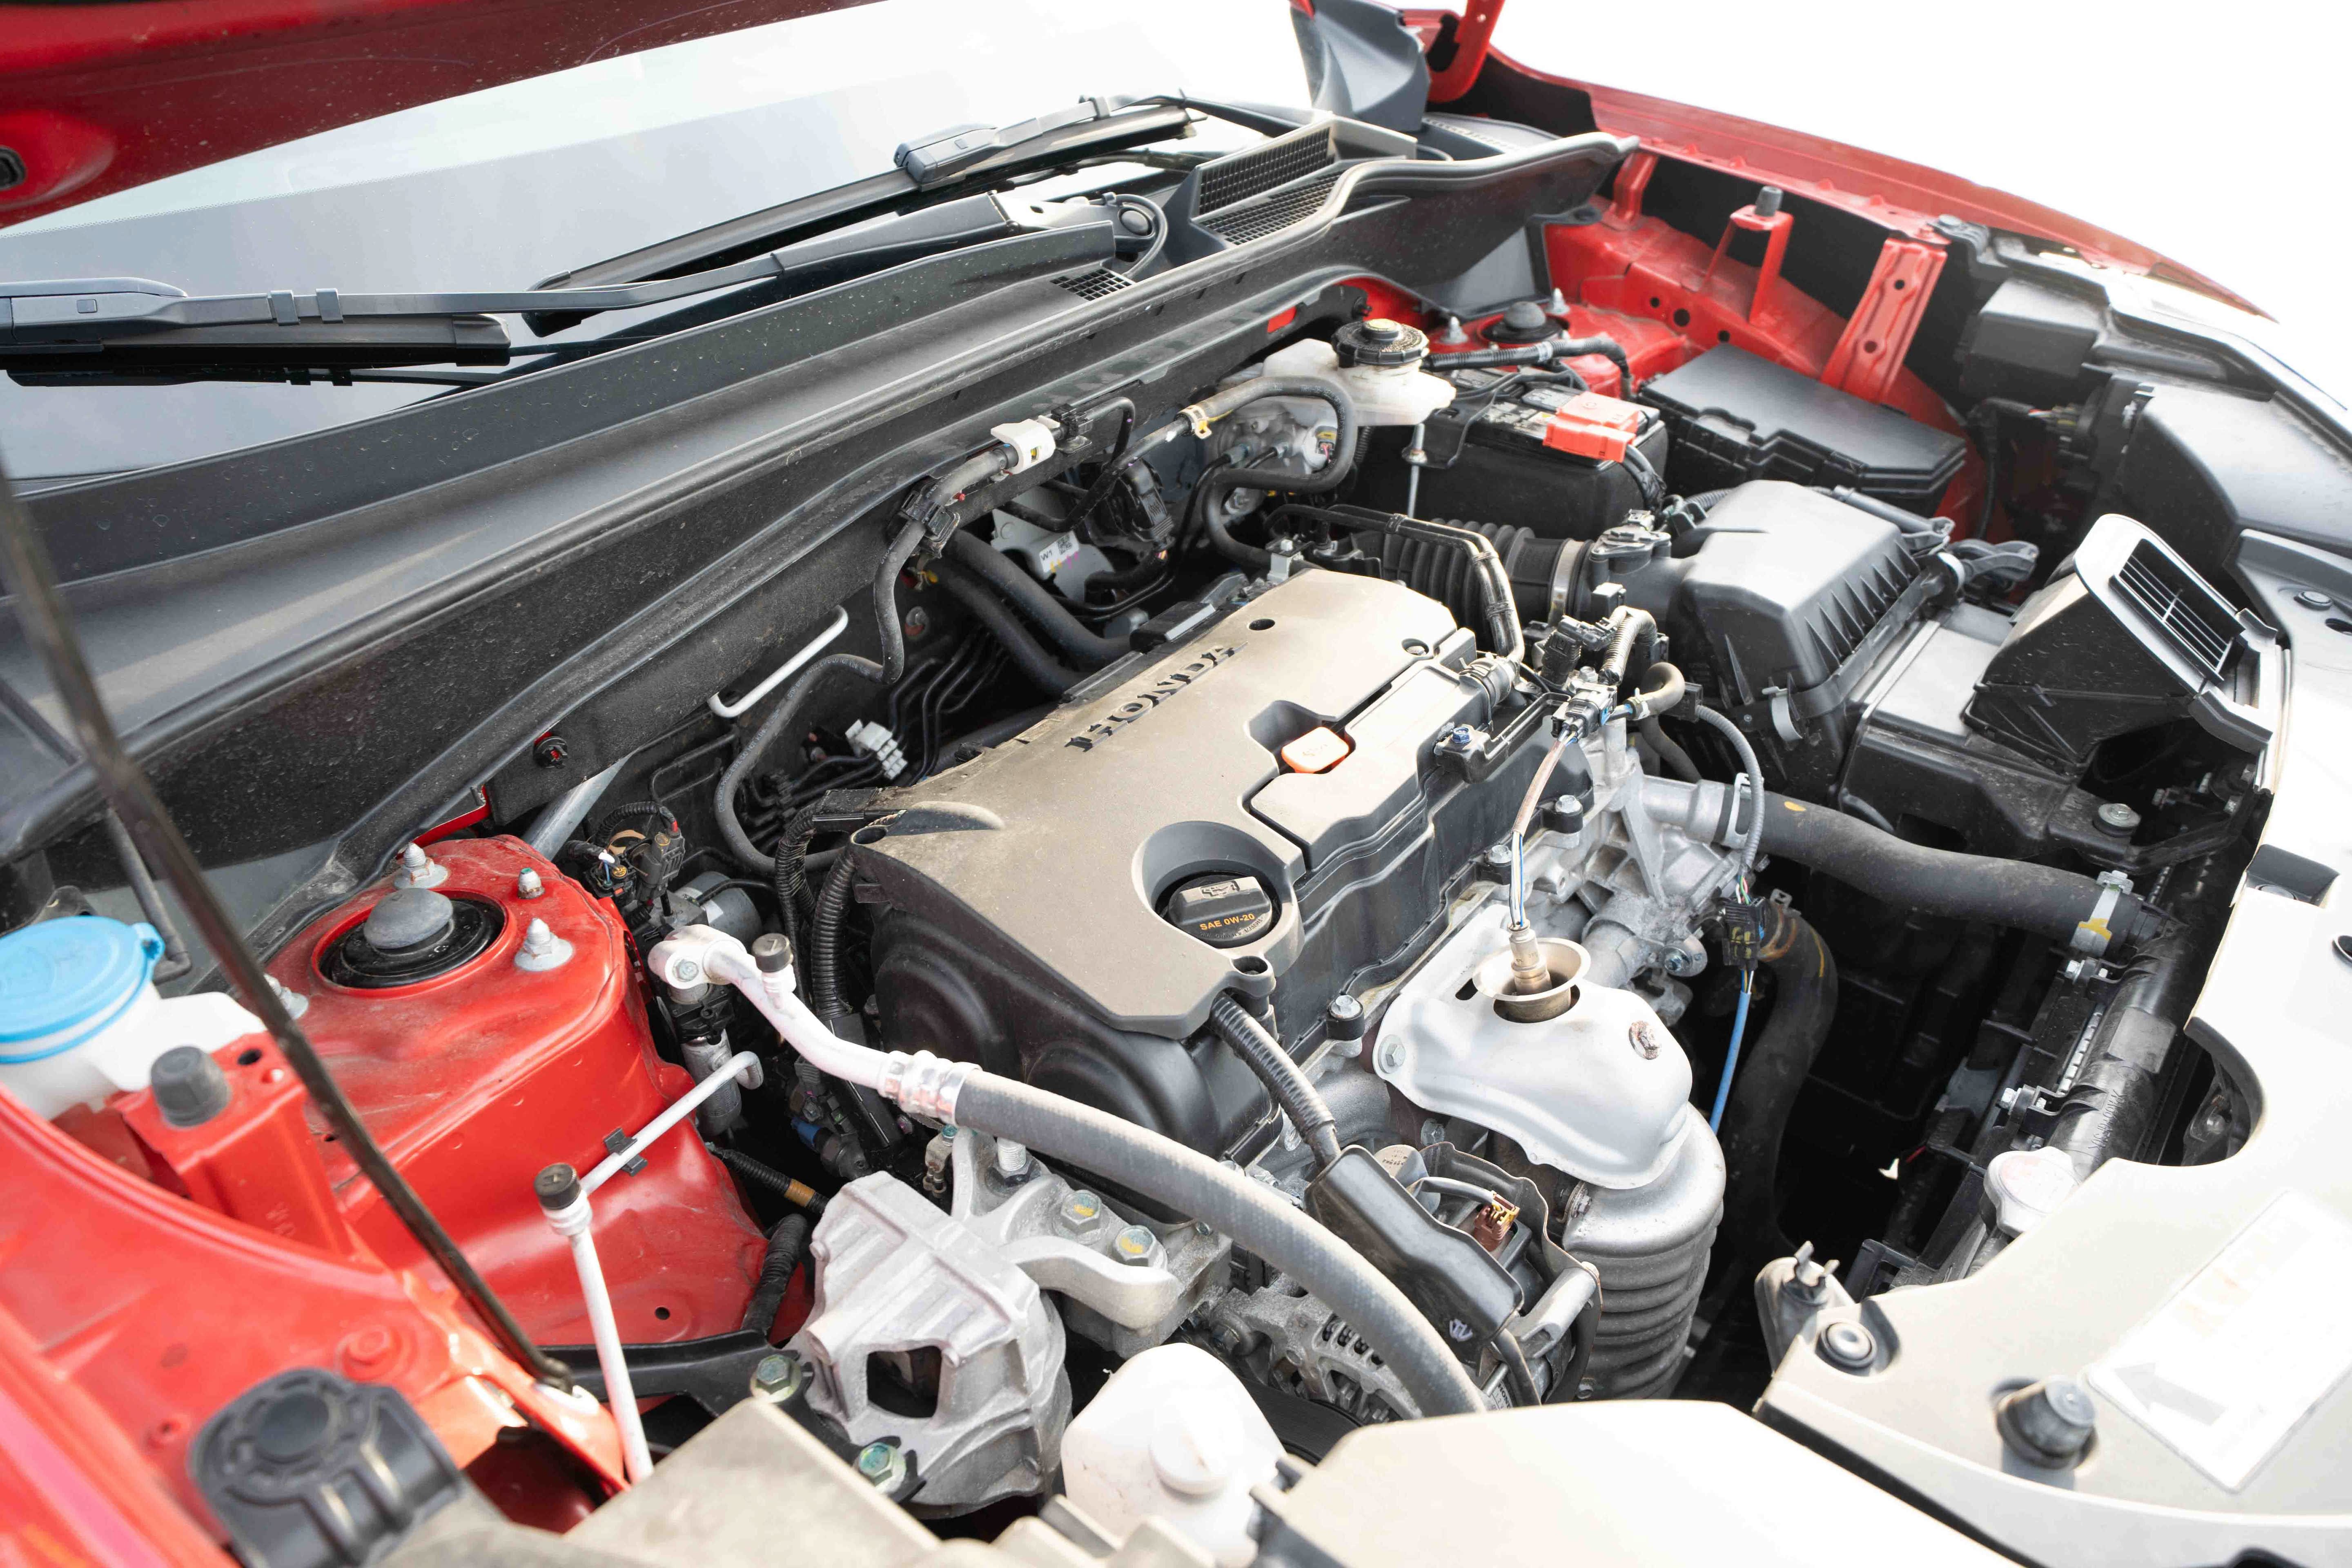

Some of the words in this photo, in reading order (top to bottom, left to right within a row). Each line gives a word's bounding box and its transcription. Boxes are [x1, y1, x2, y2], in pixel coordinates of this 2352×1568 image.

[1065, 641, 1247, 752] HONDA
[1200, 920, 1222, 930] SAE
[1224, 913, 1255, 925] 0W-20
